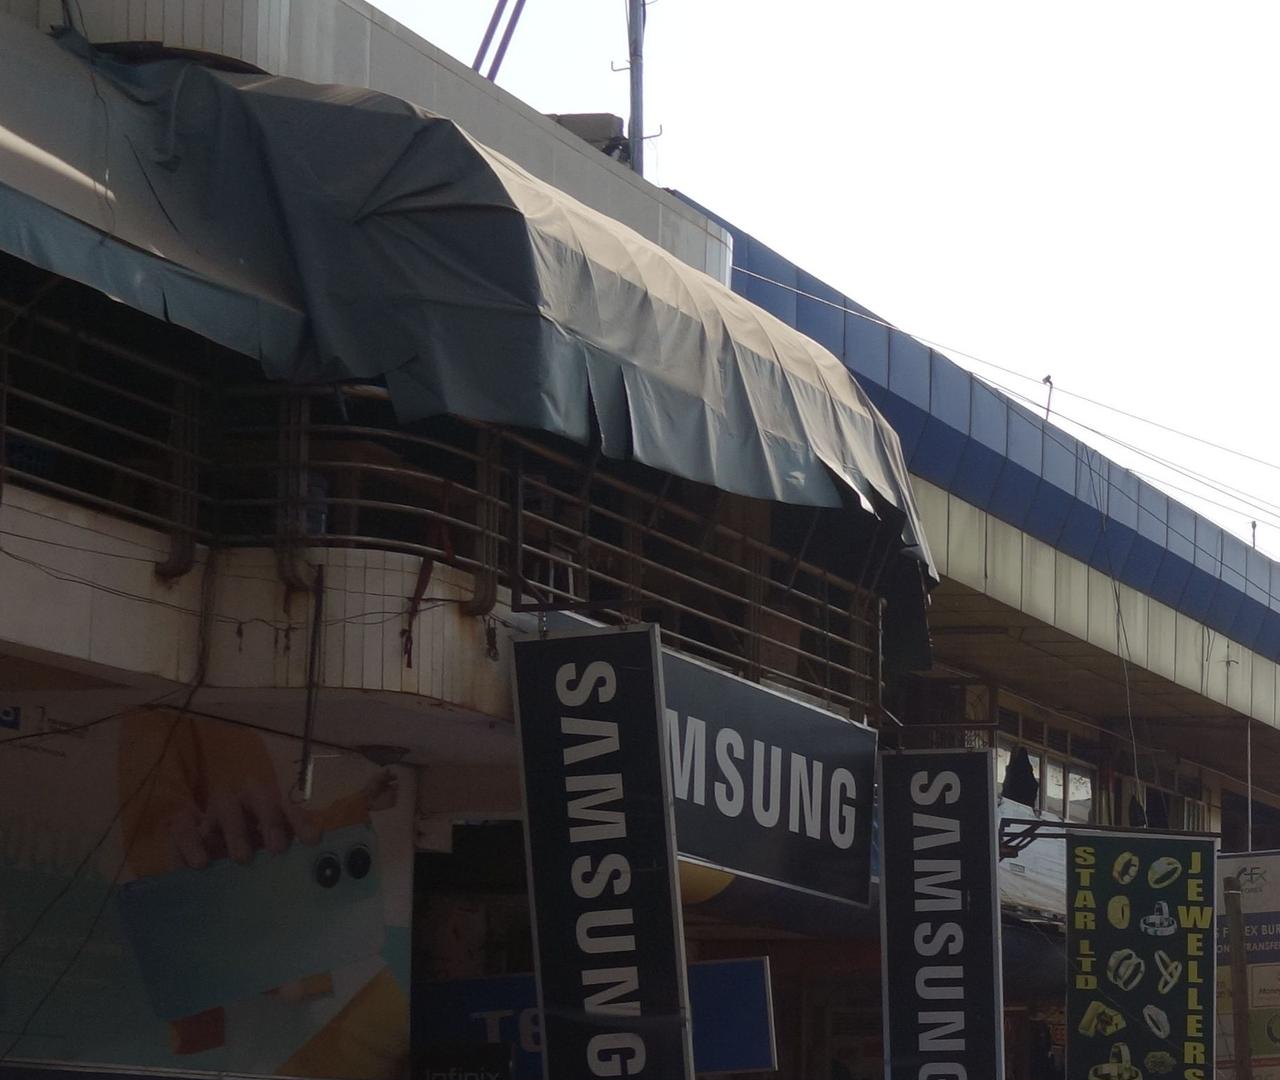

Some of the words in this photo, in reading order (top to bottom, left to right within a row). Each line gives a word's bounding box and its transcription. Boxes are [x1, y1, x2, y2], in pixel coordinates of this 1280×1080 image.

[555, 660, 647, 1078] SAMSUNG
[1074, 847, 1097, 930] STAR
[1075, 939, 1098, 990] LTD
